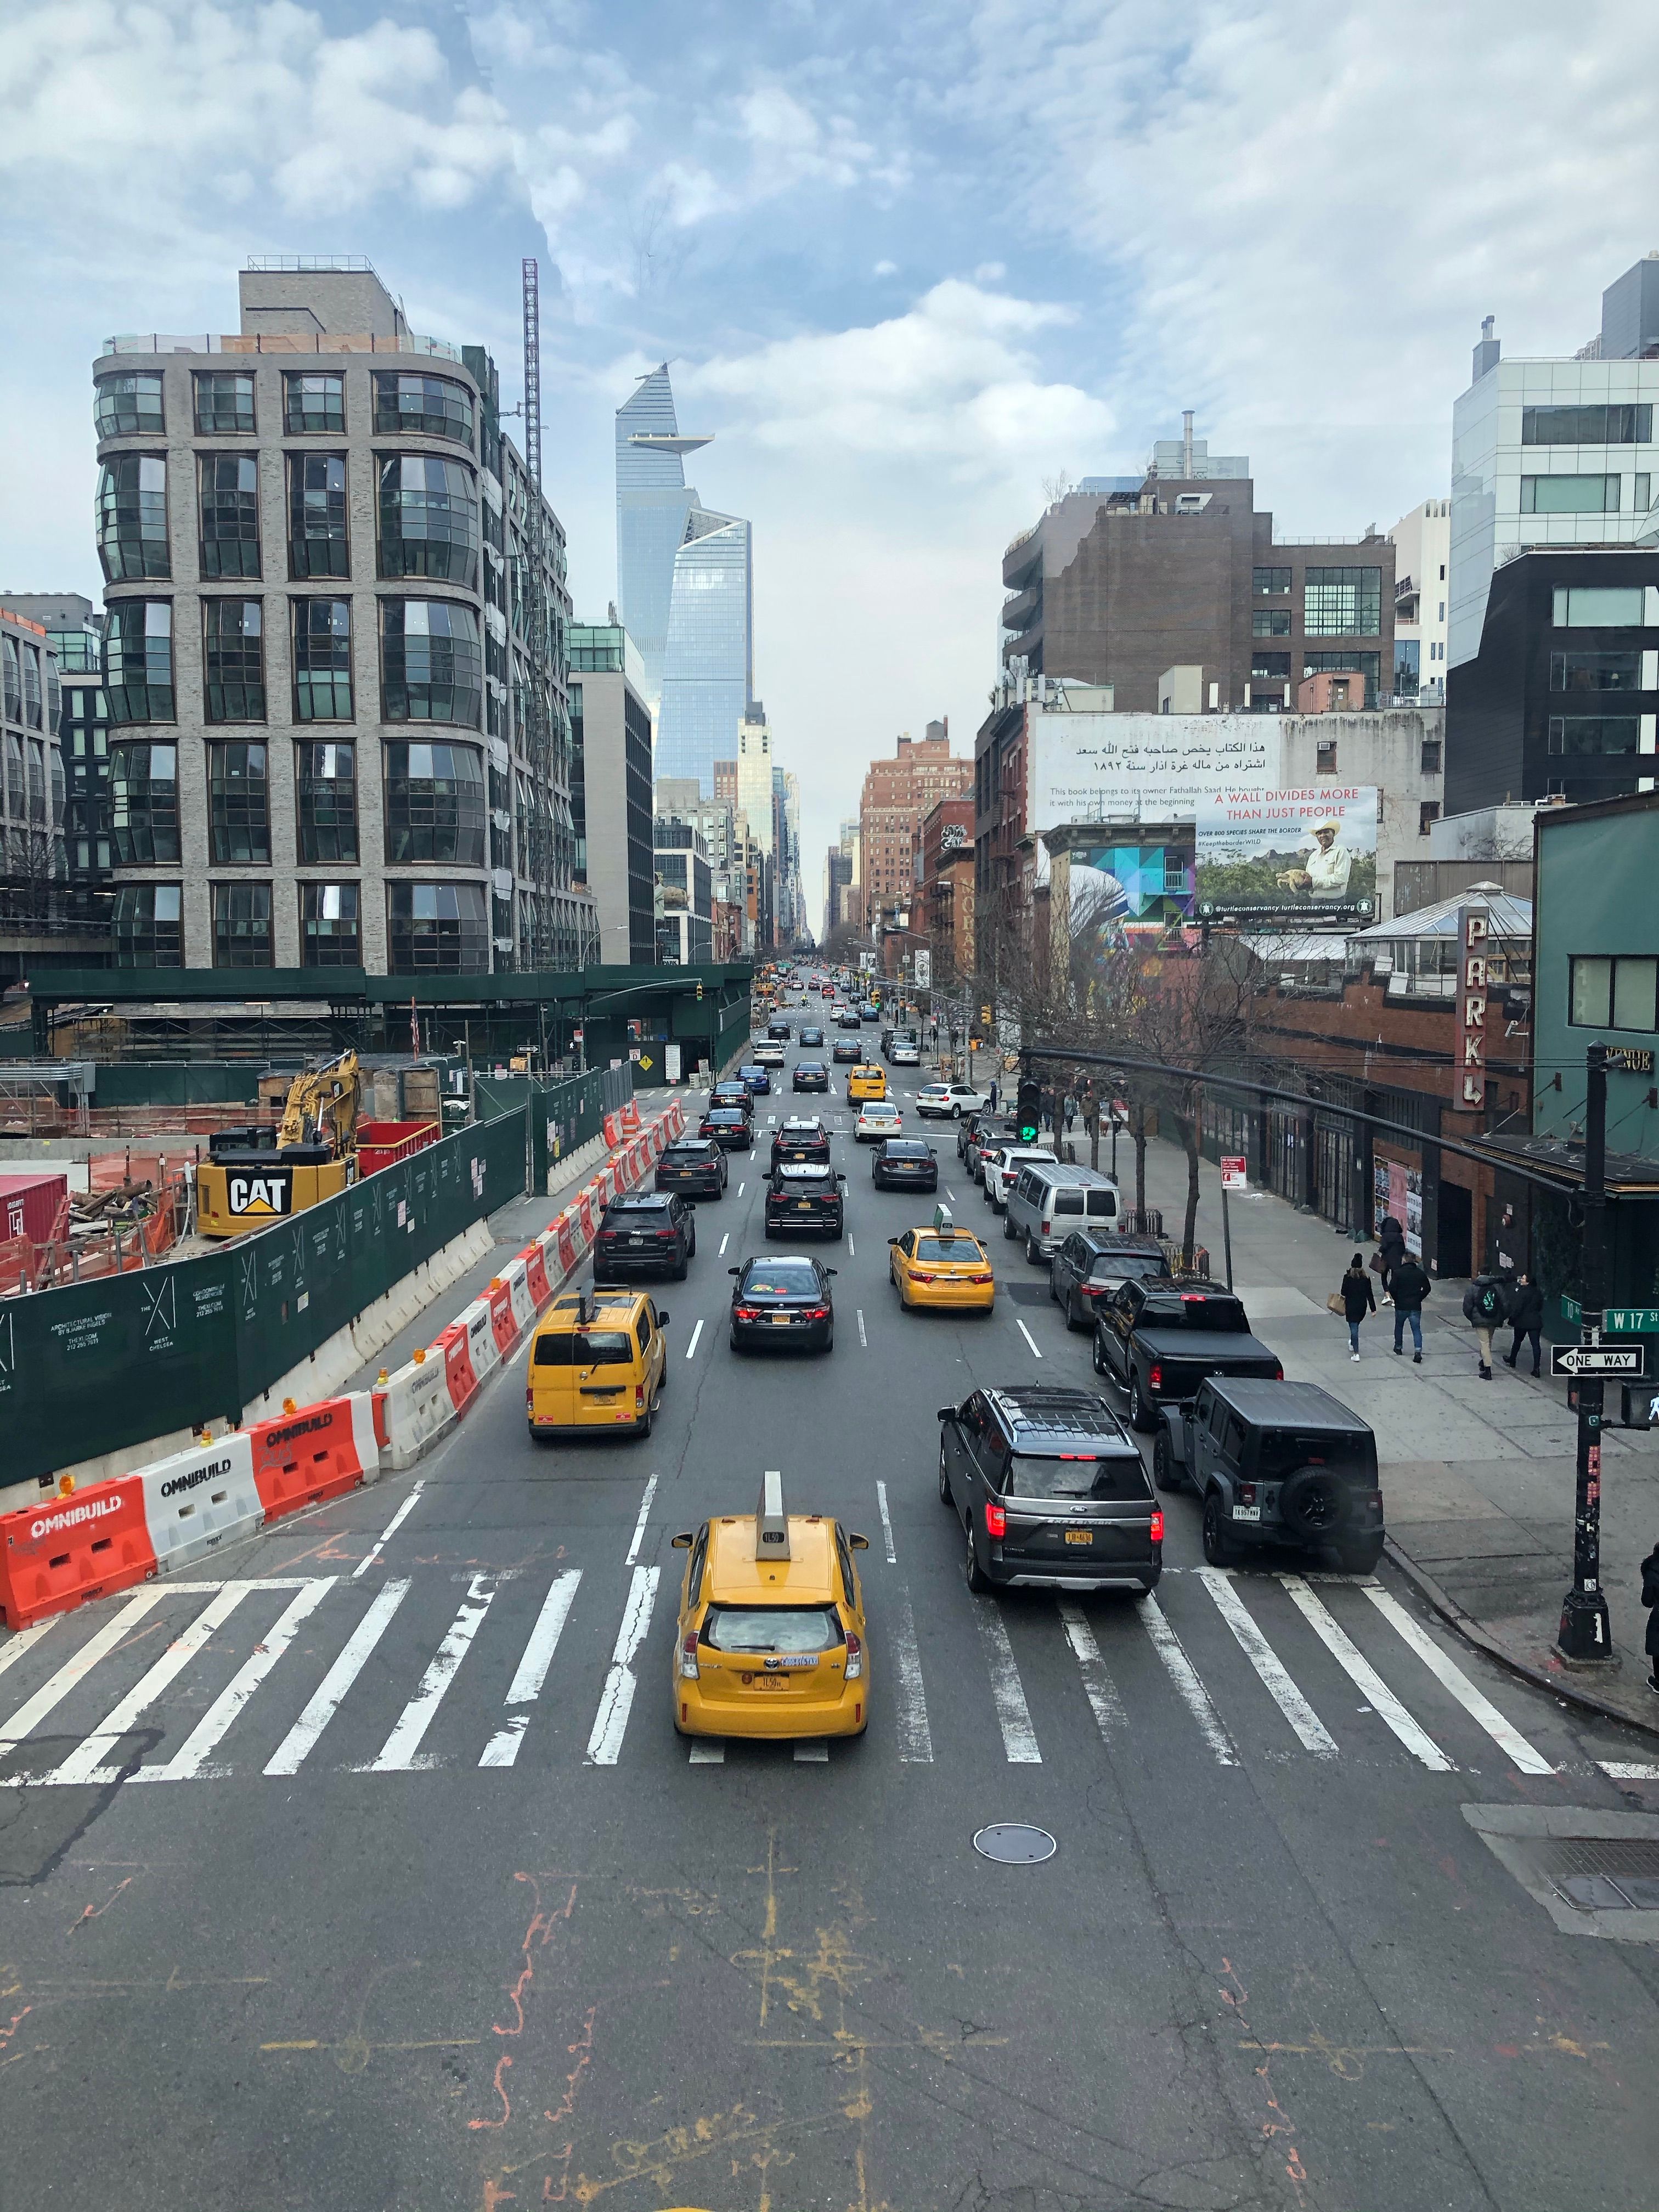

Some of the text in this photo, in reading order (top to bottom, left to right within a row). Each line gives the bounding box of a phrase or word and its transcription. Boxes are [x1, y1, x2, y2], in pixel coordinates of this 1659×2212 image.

[1215, 742, 1245, 757] الكتاب
[1250, 741, 1265, 752] هذا
[1216, 761, 1229, 771] من
[1090, 788, 1118, 796] belongs
[1214, 788, 1358, 804] A WALL DIVIDES MORE
[1160, 798, 1195, 807] beginning
[1227, 806, 1345, 820] THAN JUST PEOPLE
[1465, 914, 1487, 1066] PARK
[230, 1178, 286, 1213] CAT
[1567, 1301, 1573, 1319] 10
[50, 1312, 112, 1331] ARCHITECTURAL VISION
[87, 1319, 105, 1328] INGELS
[1613, 1312, 1658, 1329] W 17 St
[149, 1341, 173, 1351] CHELSEA
[1566, 1355, 1630, 1366] ONE WAY
[161, 1459, 231, 1497] OMNIBUILD
[31, 1496, 122, 1538] OMNIBUILD
